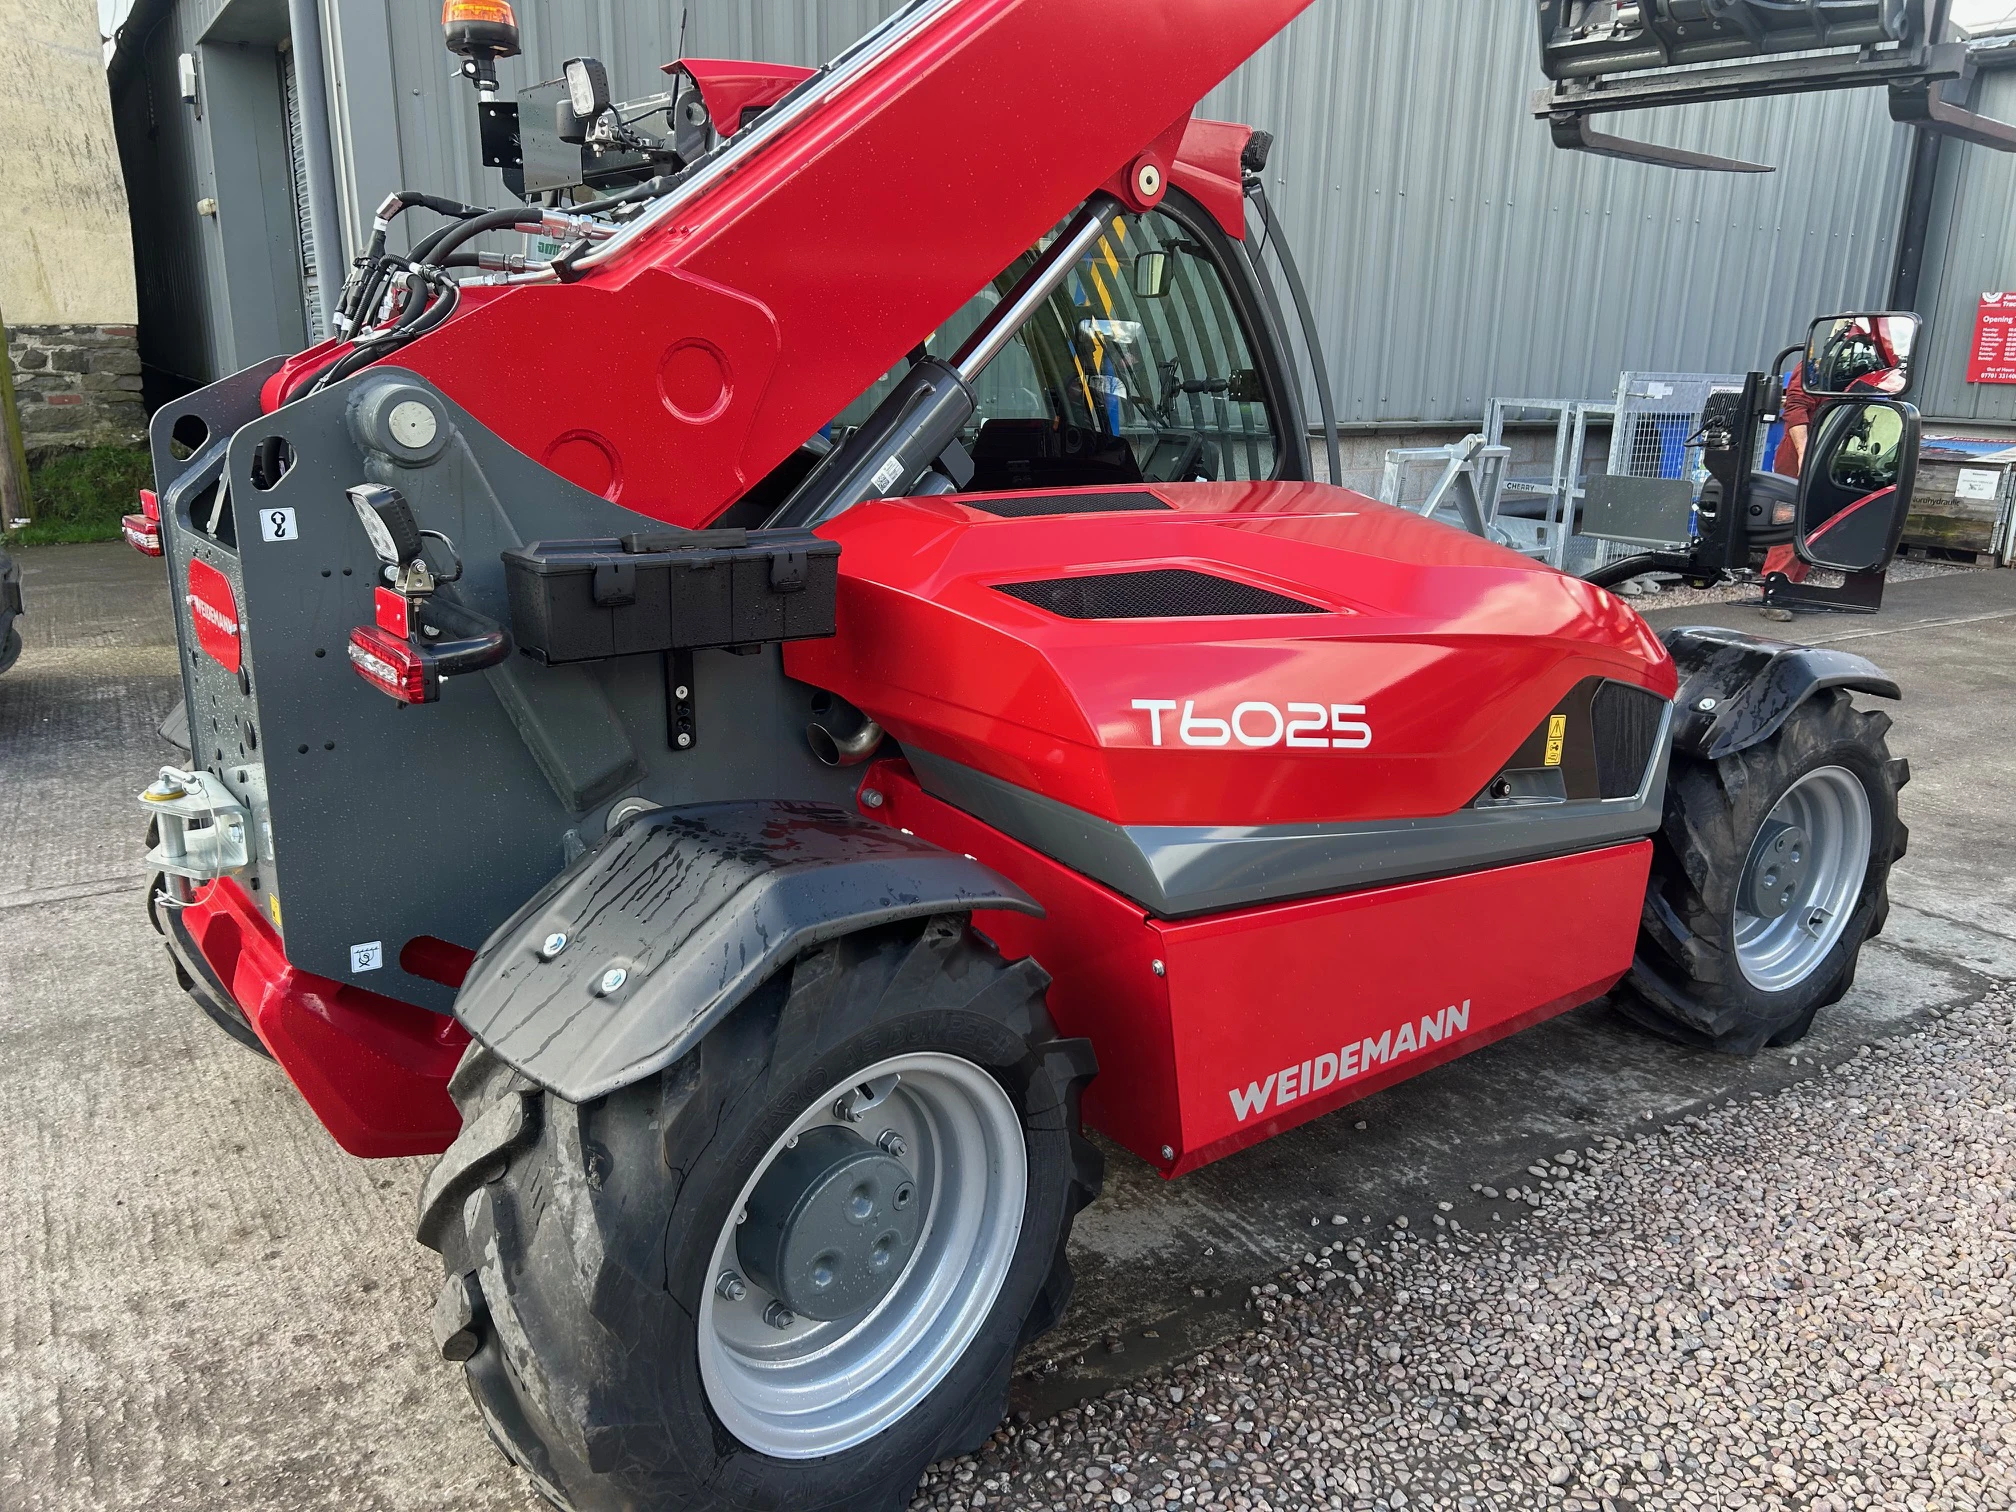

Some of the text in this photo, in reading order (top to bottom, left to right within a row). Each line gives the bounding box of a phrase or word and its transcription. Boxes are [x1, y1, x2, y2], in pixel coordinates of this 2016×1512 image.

[1983, 315, 2013, 324] Opening
[1506, 482, 1535, 492] CHERRY
[1131, 699, 1372, 749] T6025
[1228, 998, 1471, 1122] WEIDEMANN
